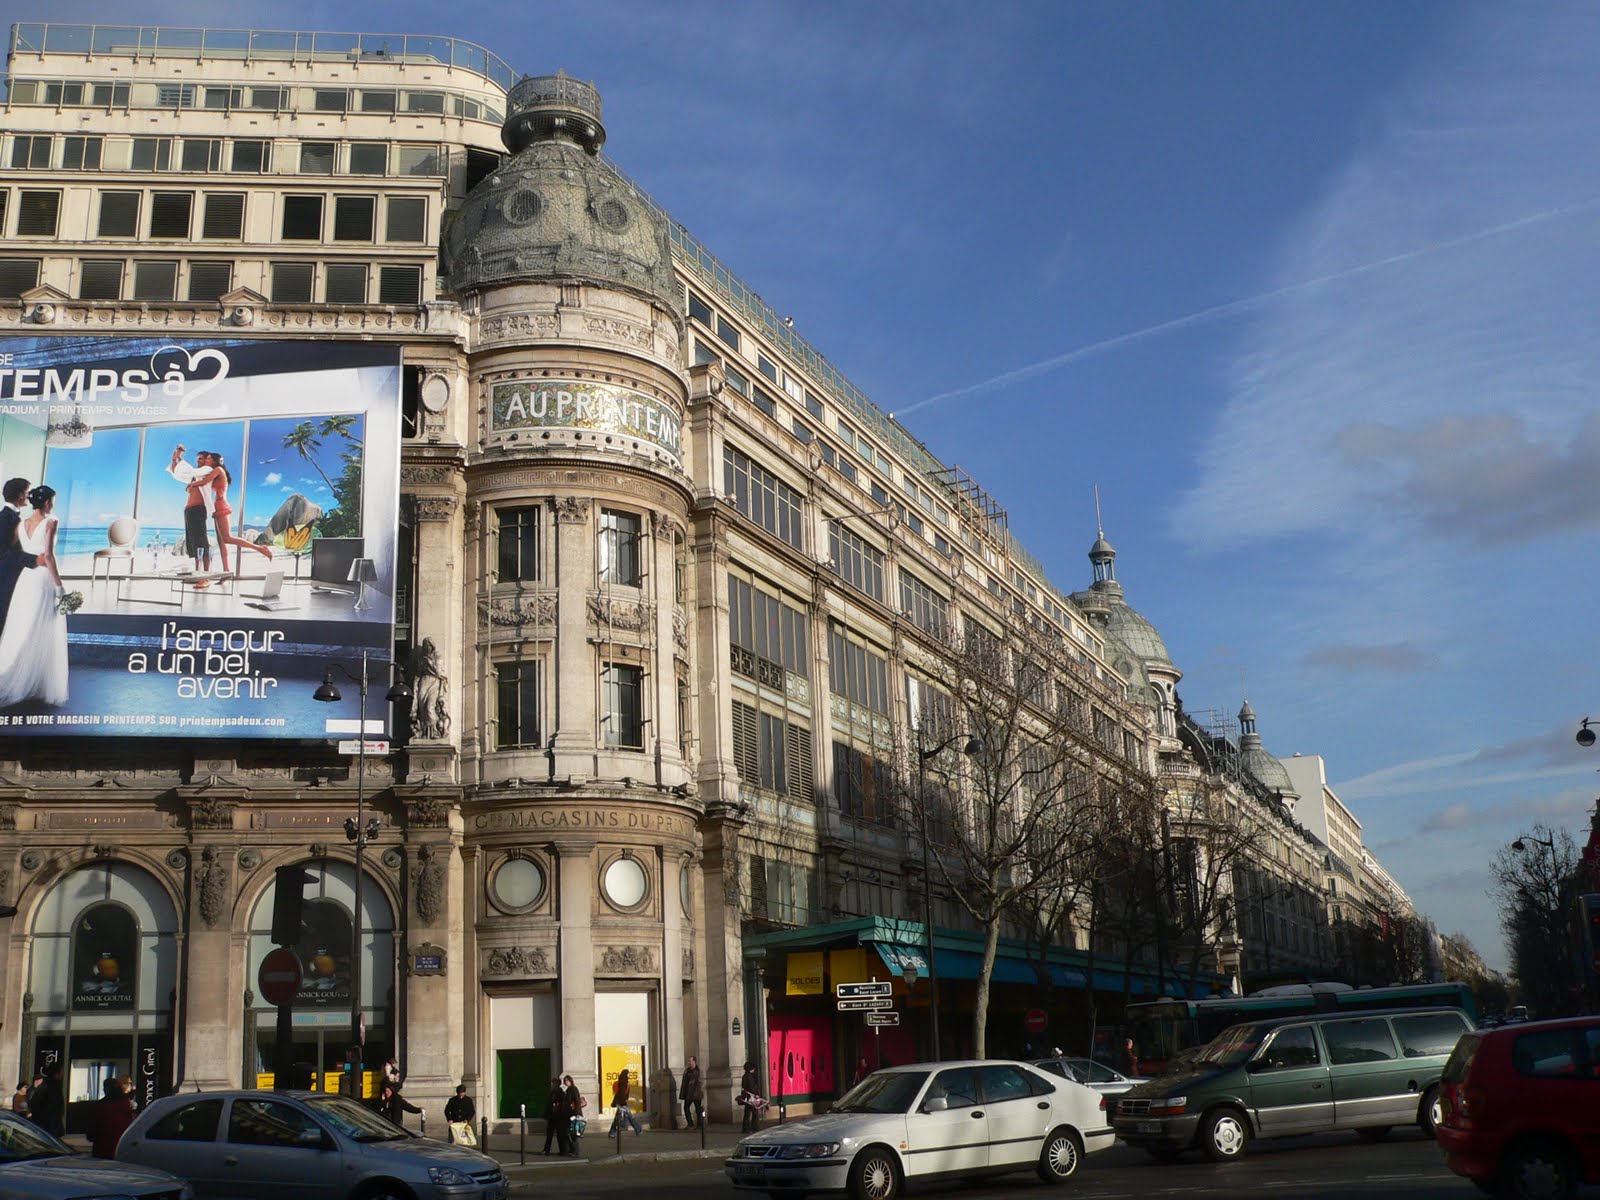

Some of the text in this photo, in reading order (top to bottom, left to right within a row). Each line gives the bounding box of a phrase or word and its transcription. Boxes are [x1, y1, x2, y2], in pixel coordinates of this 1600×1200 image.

[162, 362, 186, 396] à
[178, 348, 230, 416] 2
[50, 405, 114, 415] PRINTEMPS
[117, 405, 168, 416] VOYAGES
[505, 391, 680, 449] AU PRINTEMP
[161, 622, 285, 652] l'amour
[128, 647, 250, 675] a un bel
[176, 670, 278, 699] avenir
[12, 715, 23, 725] DE
[26, 715, 54, 725] VOTRE
[57, 714, 100, 725] MAGASIN
[103, 714, 156, 725] PRINTEMPS
[159, 715, 177, 725] SUR
[180, 715, 285, 728] printempsadeux.com
[508, 810, 619, 828] MAGASINS
[628, 812, 651, 828] DU
[790, 976, 821, 985] SOLDES
[74, 994, 132, 1003] ANNICK GOUTAL
